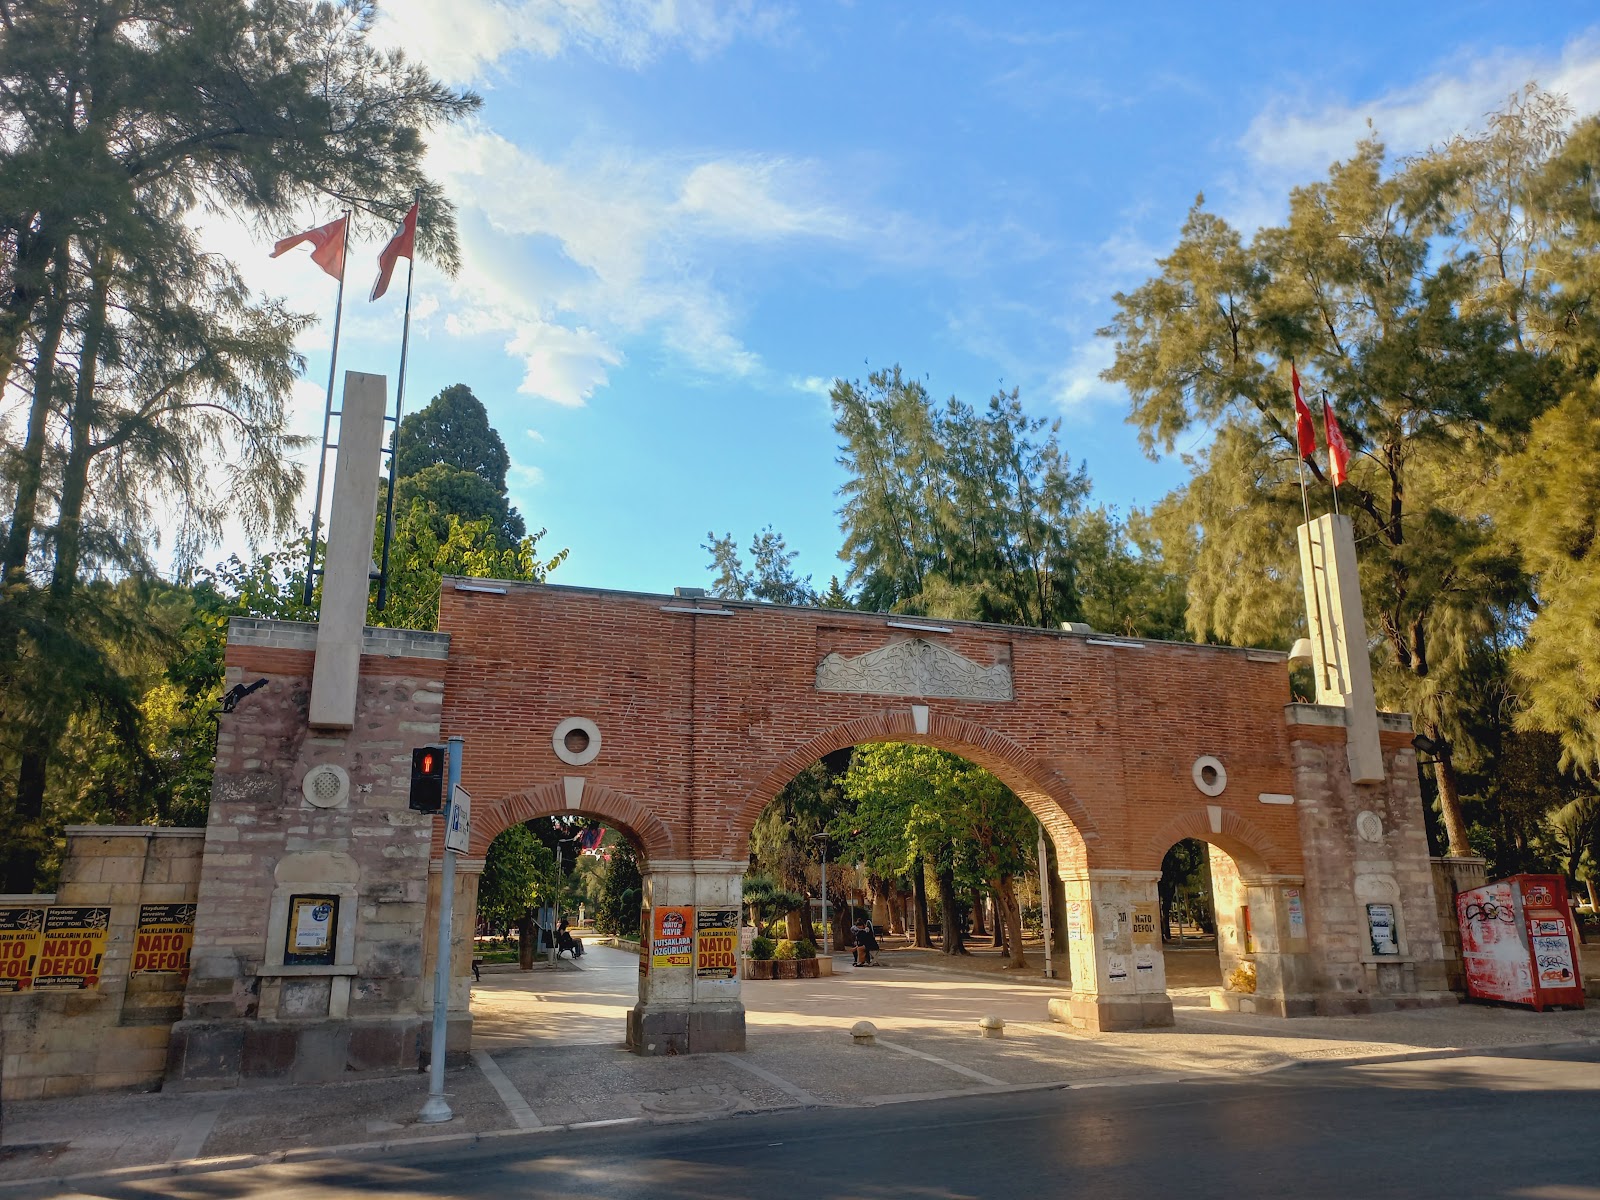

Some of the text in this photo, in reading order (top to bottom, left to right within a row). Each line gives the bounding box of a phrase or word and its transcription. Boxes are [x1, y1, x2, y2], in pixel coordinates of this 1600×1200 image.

[1134, 914, 1152, 923] NATO
[662, 928, 681, 936] HAYIR
[1133, 924, 1156, 933] DEFOL!
[82, 931, 103, 939] KATİLİ
[136, 934, 184, 952] NATO
[654, 937, 691, 947] TUTSAKLARA
[698, 937, 732, 952] NATO
[42, 939, 92, 957] NATO
[654, 946, 691, 956] ÖZGÜRLÜK!
[134, 947, 192, 970] DEFOL!
[38, 953, 103, 976] DEFOL!
